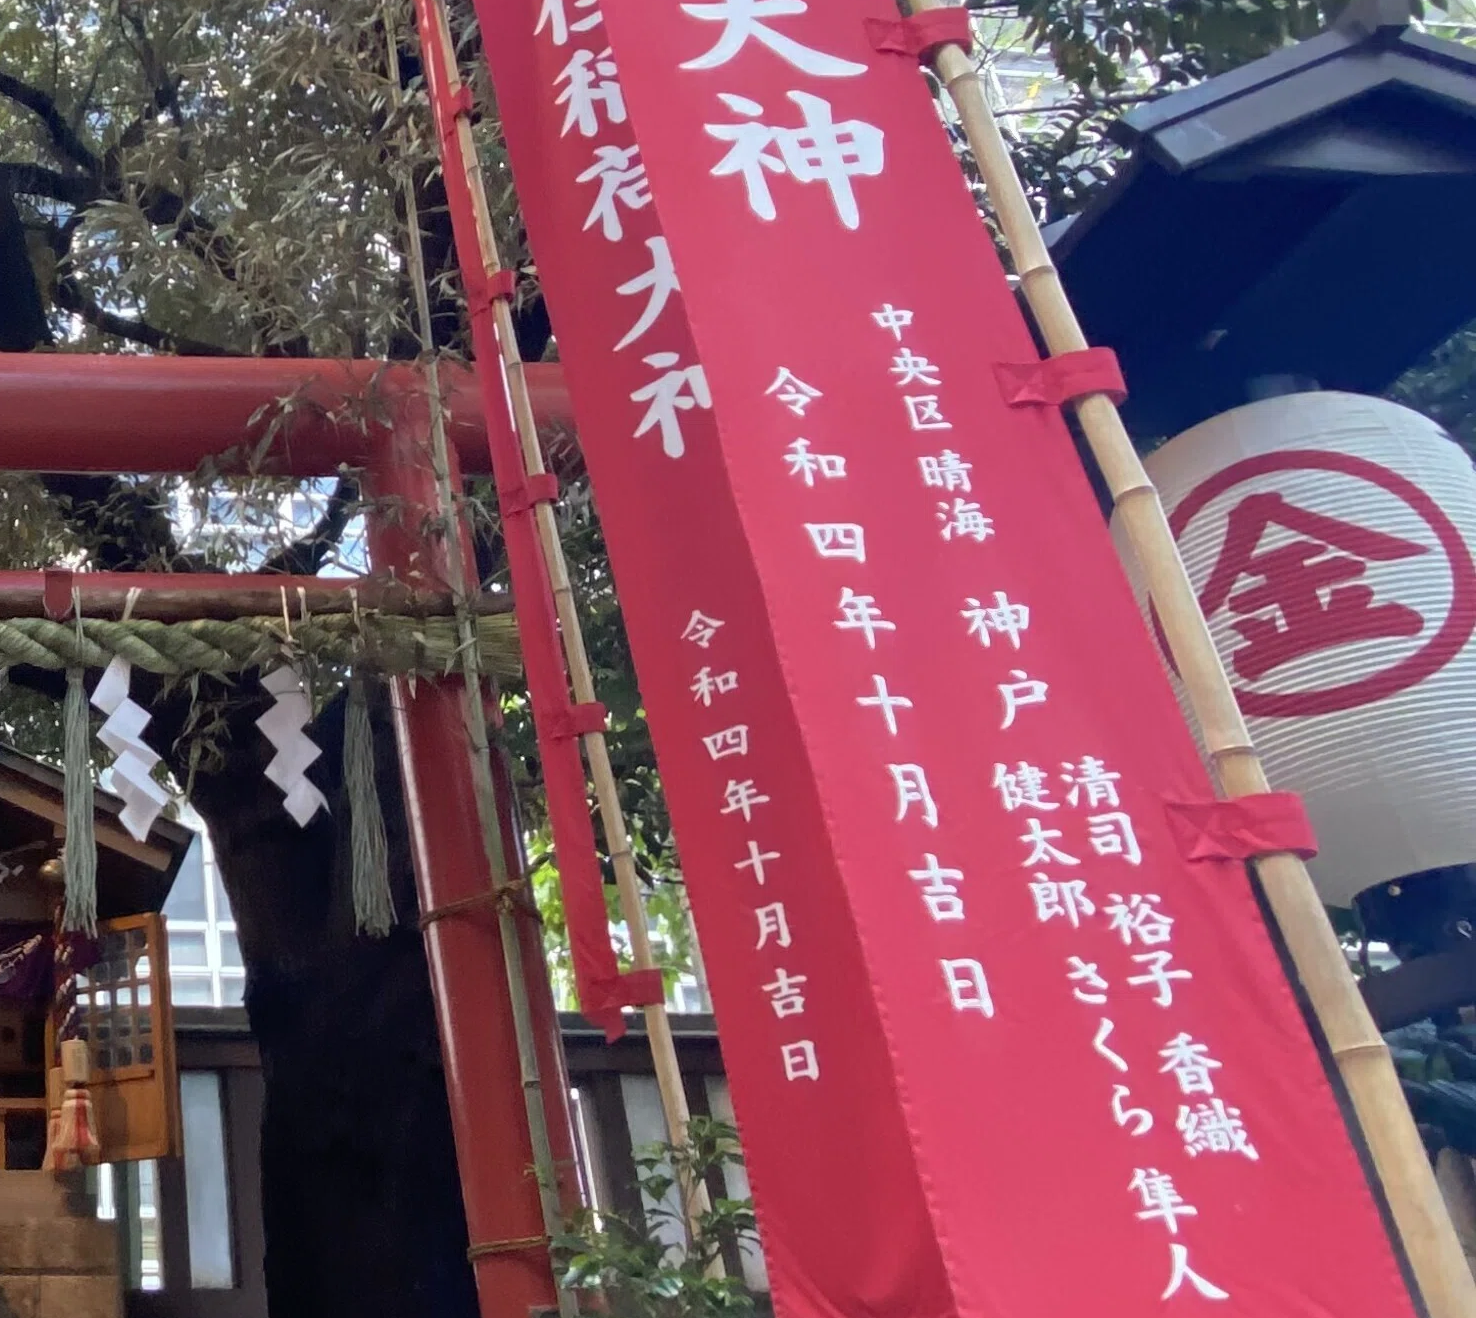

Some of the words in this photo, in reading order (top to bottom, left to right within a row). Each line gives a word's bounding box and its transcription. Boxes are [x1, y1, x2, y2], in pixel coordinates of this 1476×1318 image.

[765, 367, 995, 1018] 令和四年十月吉日
[1198, 492, 1432, 681] 金
[680, 608, 820, 1081] 令和四年十月吉日
